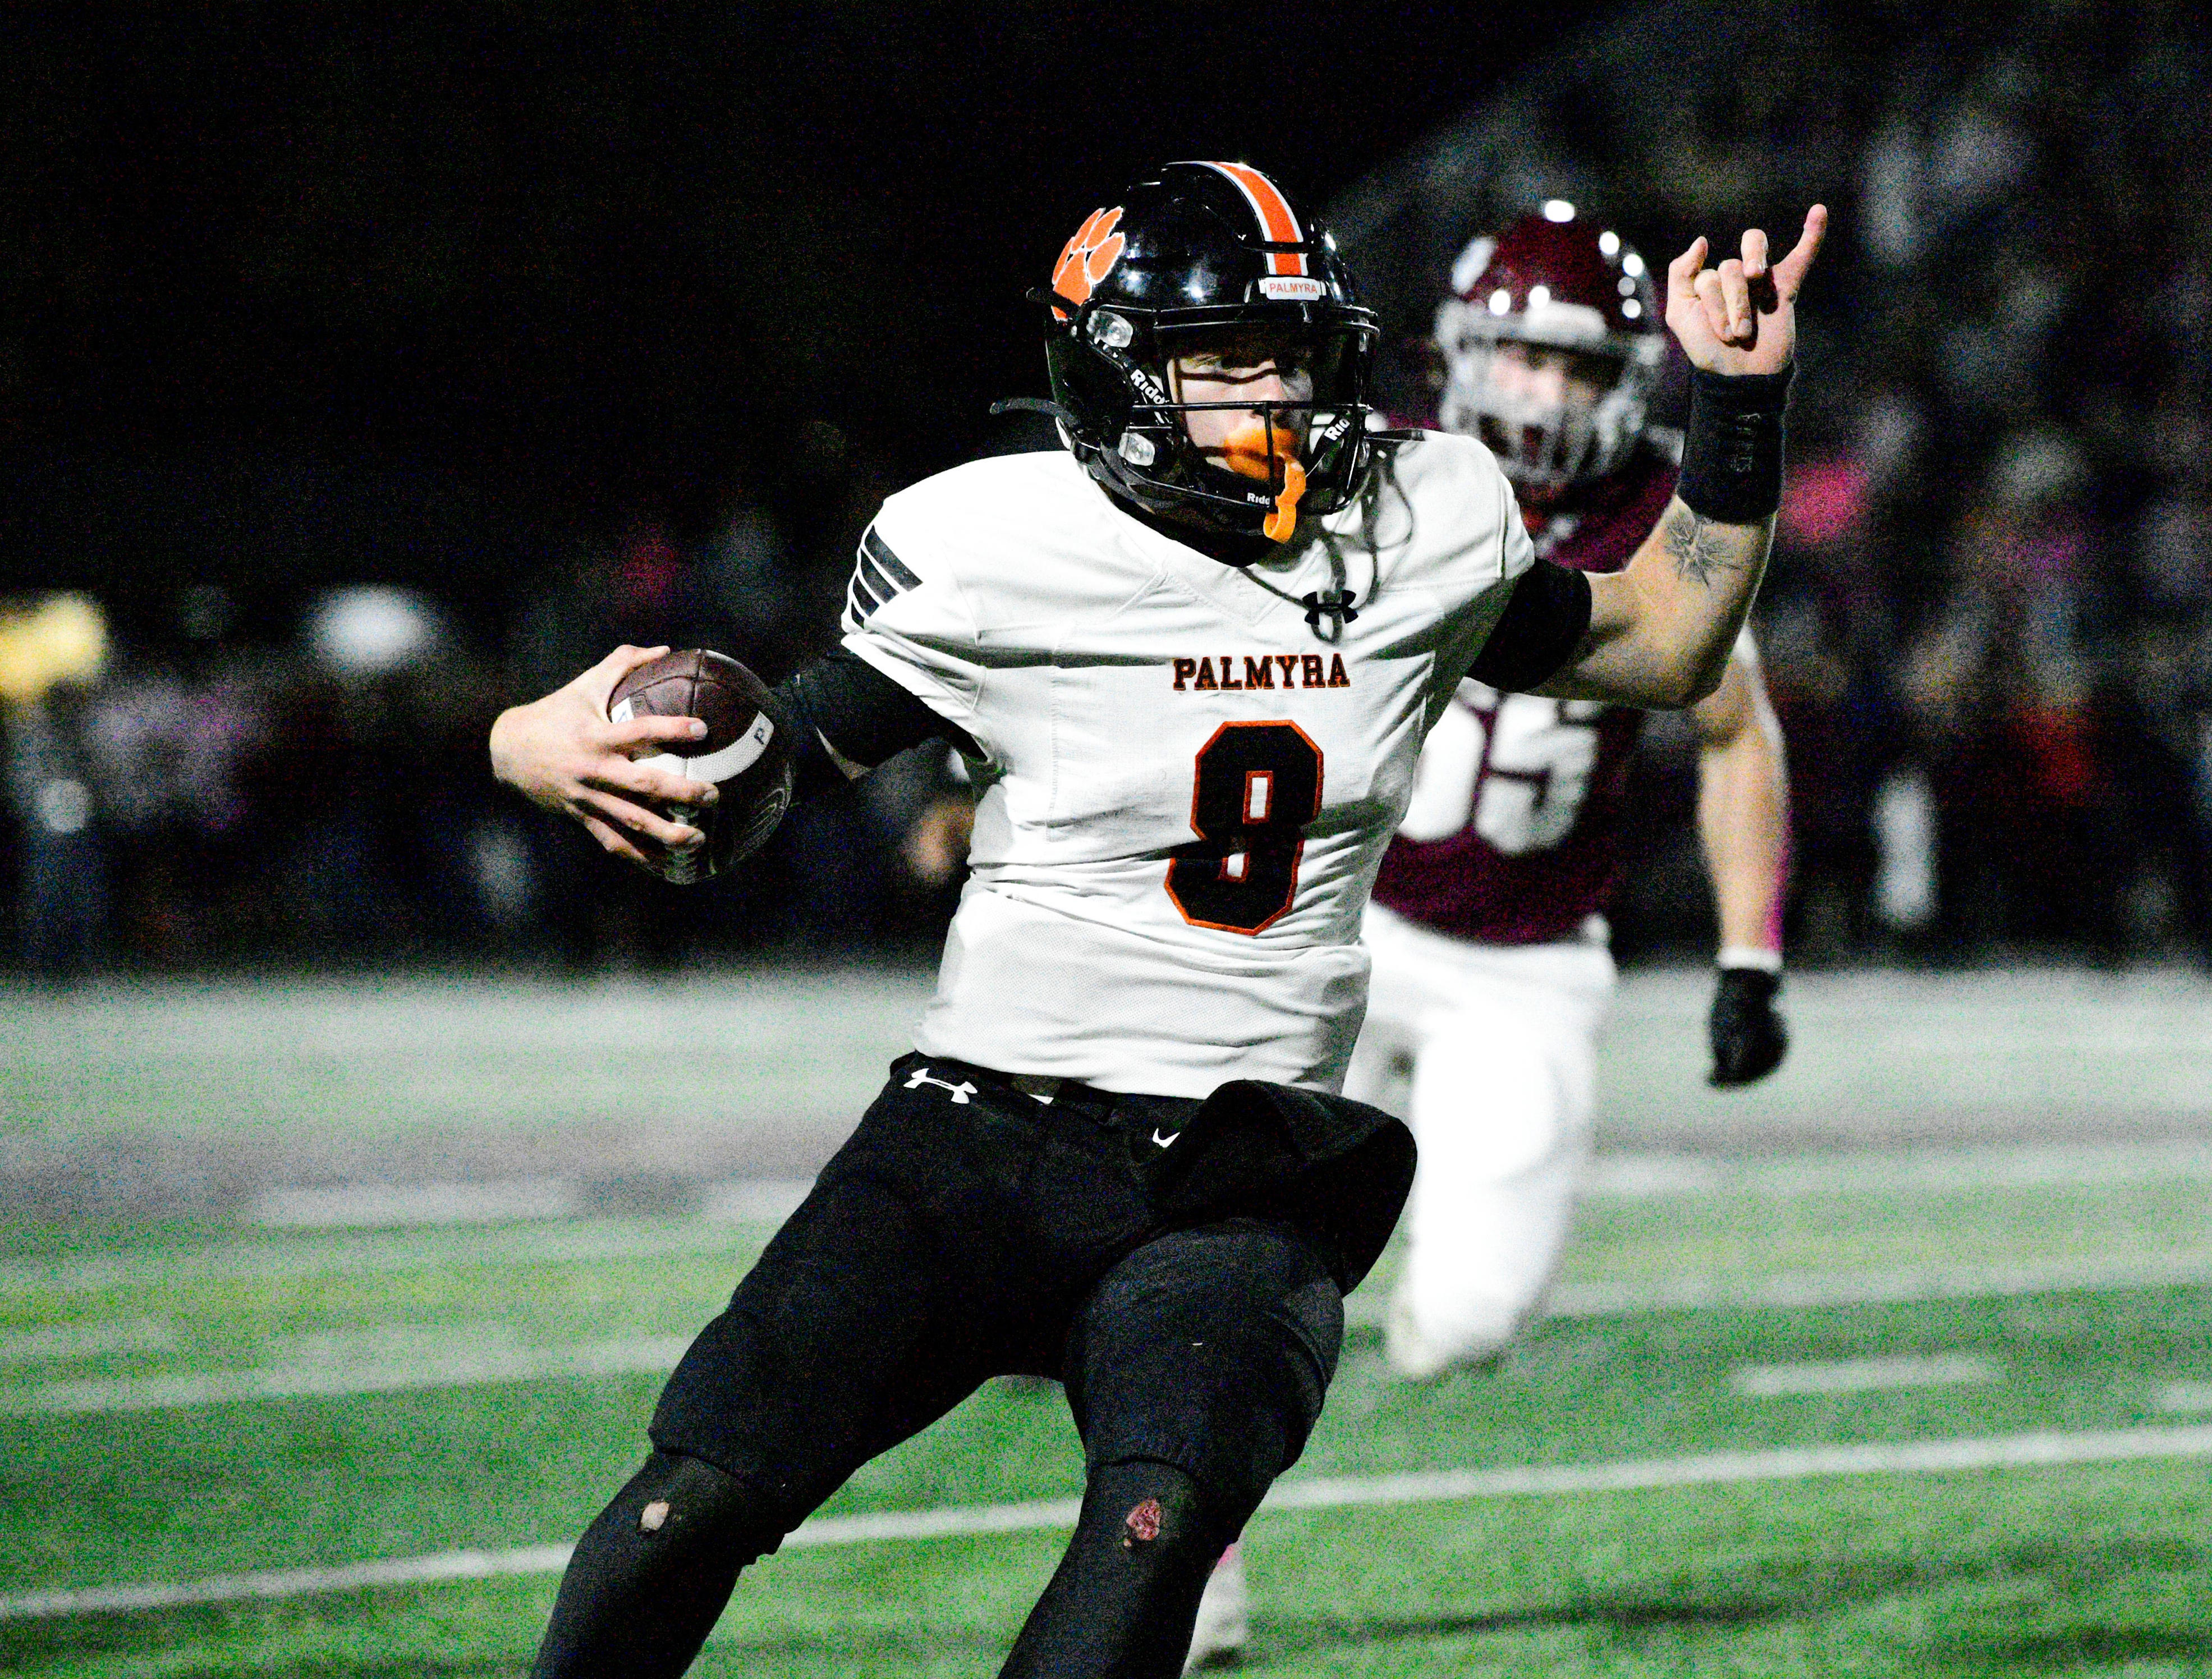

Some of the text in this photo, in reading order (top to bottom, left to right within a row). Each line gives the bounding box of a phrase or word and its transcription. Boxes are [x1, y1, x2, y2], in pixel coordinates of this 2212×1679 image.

[1269, 283, 1318, 293] PALMYRA
[1130, 369, 1165, 405] Ridd
[1173, 653, 1350, 691] PALMYRA
[1164, 719, 1324, 936] 8
